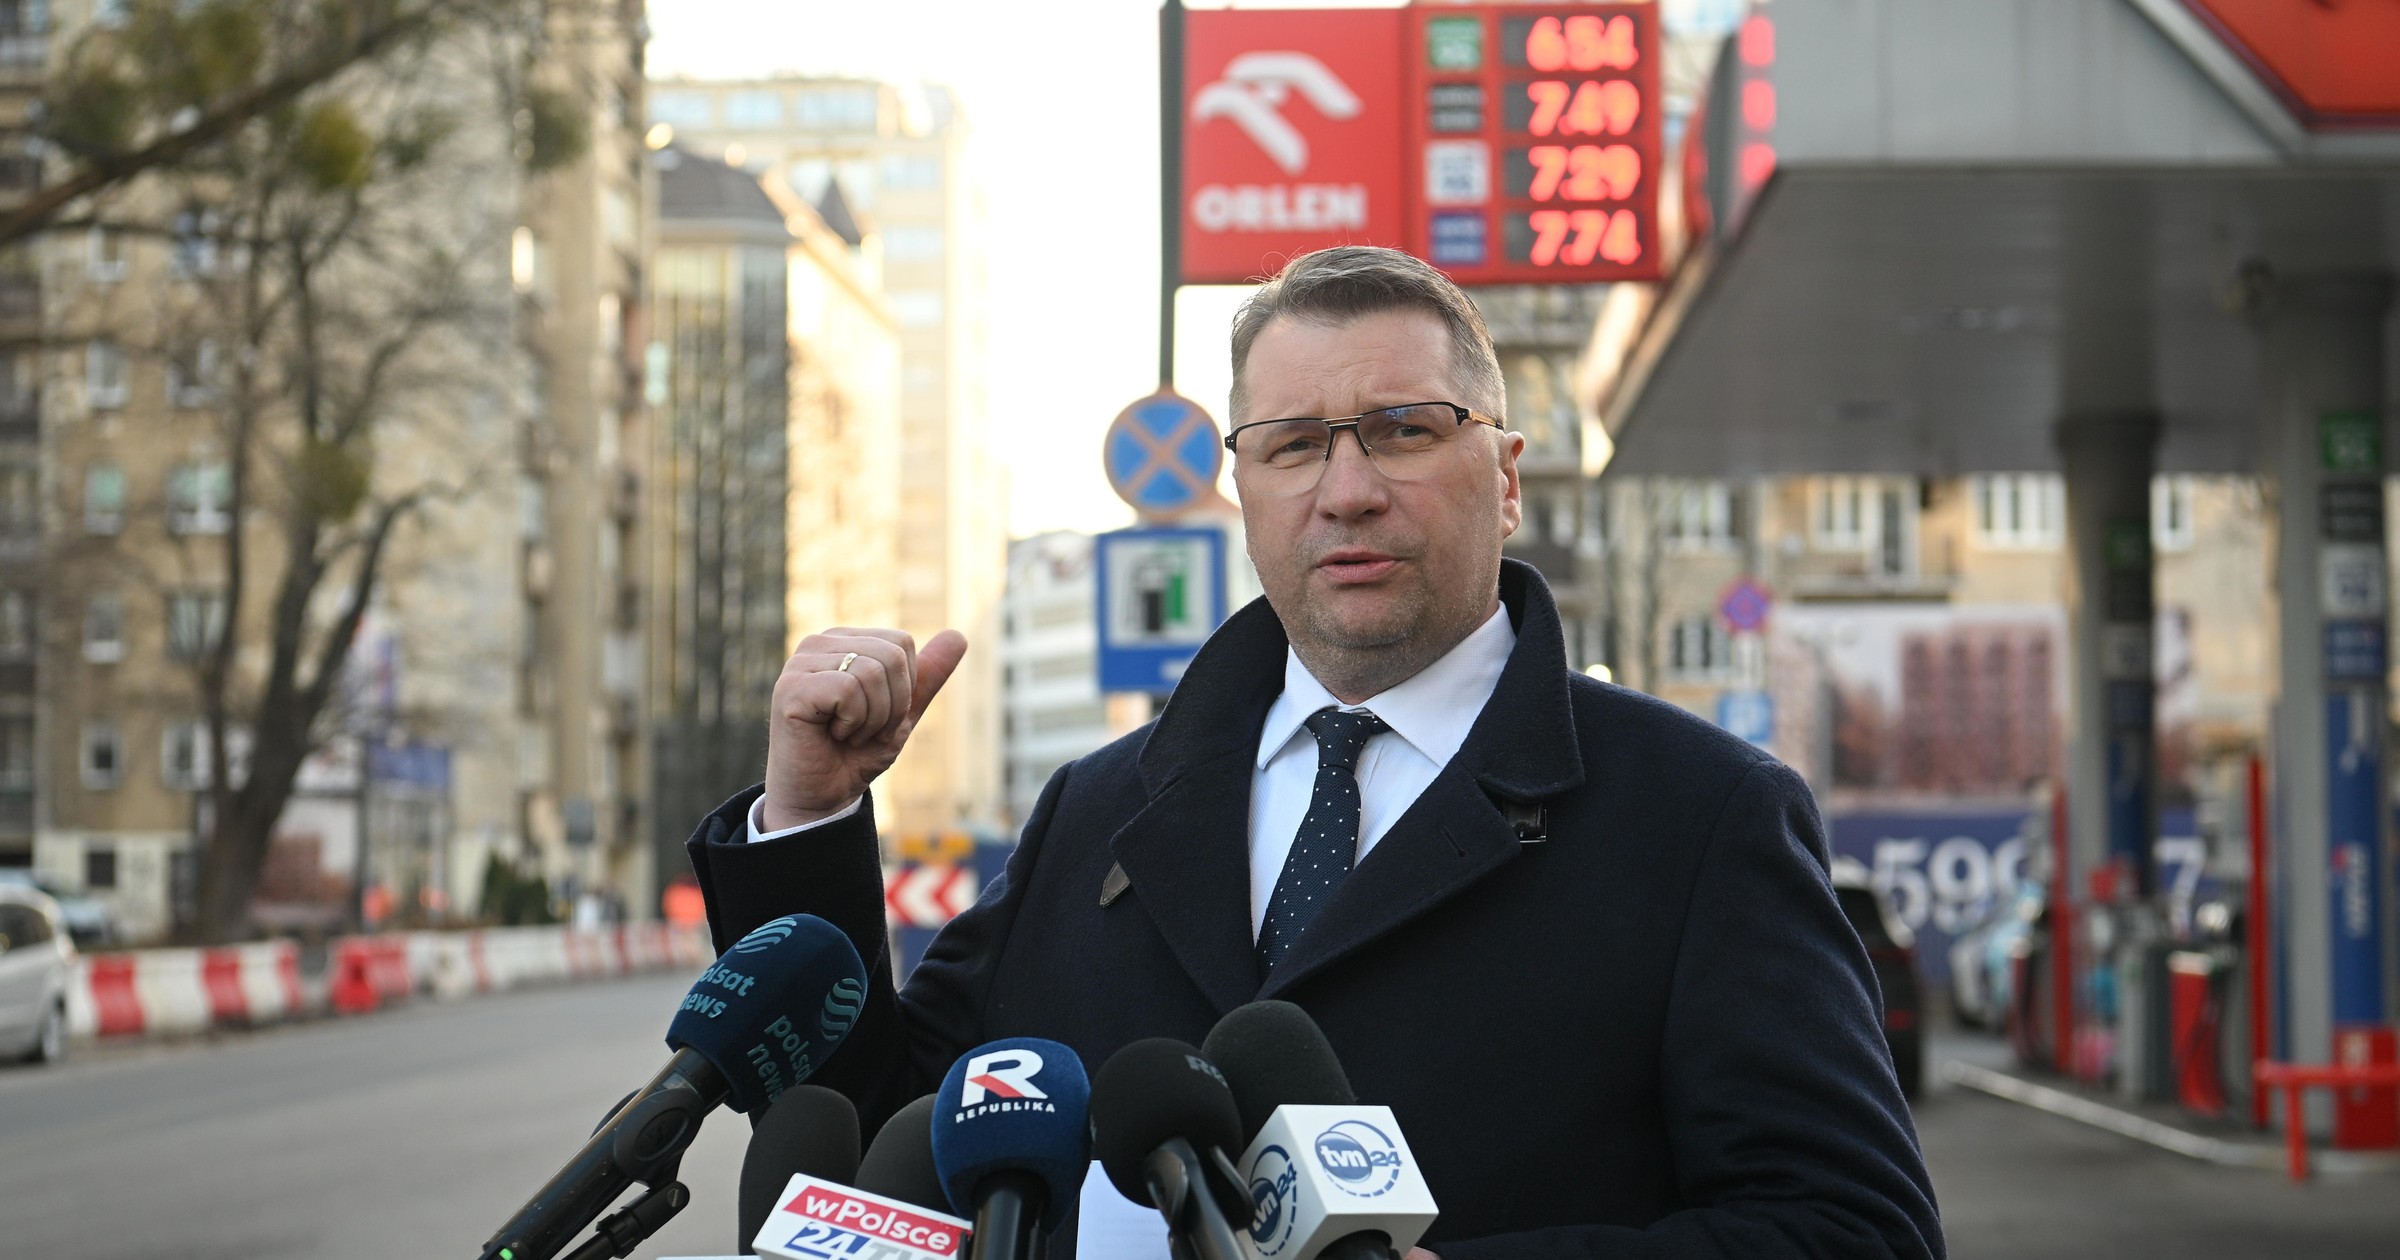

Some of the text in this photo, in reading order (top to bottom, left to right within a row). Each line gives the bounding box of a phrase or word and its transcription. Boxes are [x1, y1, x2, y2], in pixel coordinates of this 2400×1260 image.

[1528, 80, 1640, 136] 7.49
[1528, 144, 1641, 201] 7.29
[1193, 184, 1368, 232] ORLEN
[1529, 209, 1642, 265] 7.74
[698, 963, 755, 997] olsat
[763, 1014, 814, 1087] polsa
[961, 1049, 1049, 1108] R
[955, 1100, 1056, 1124] REPUBLIKA
[1276, 1162, 1297, 1200] 24
[1319, 1145, 1403, 1167] tvn 24
[789, 1222, 858, 1260] 24
[804, 1195, 951, 1251] wPolsce
